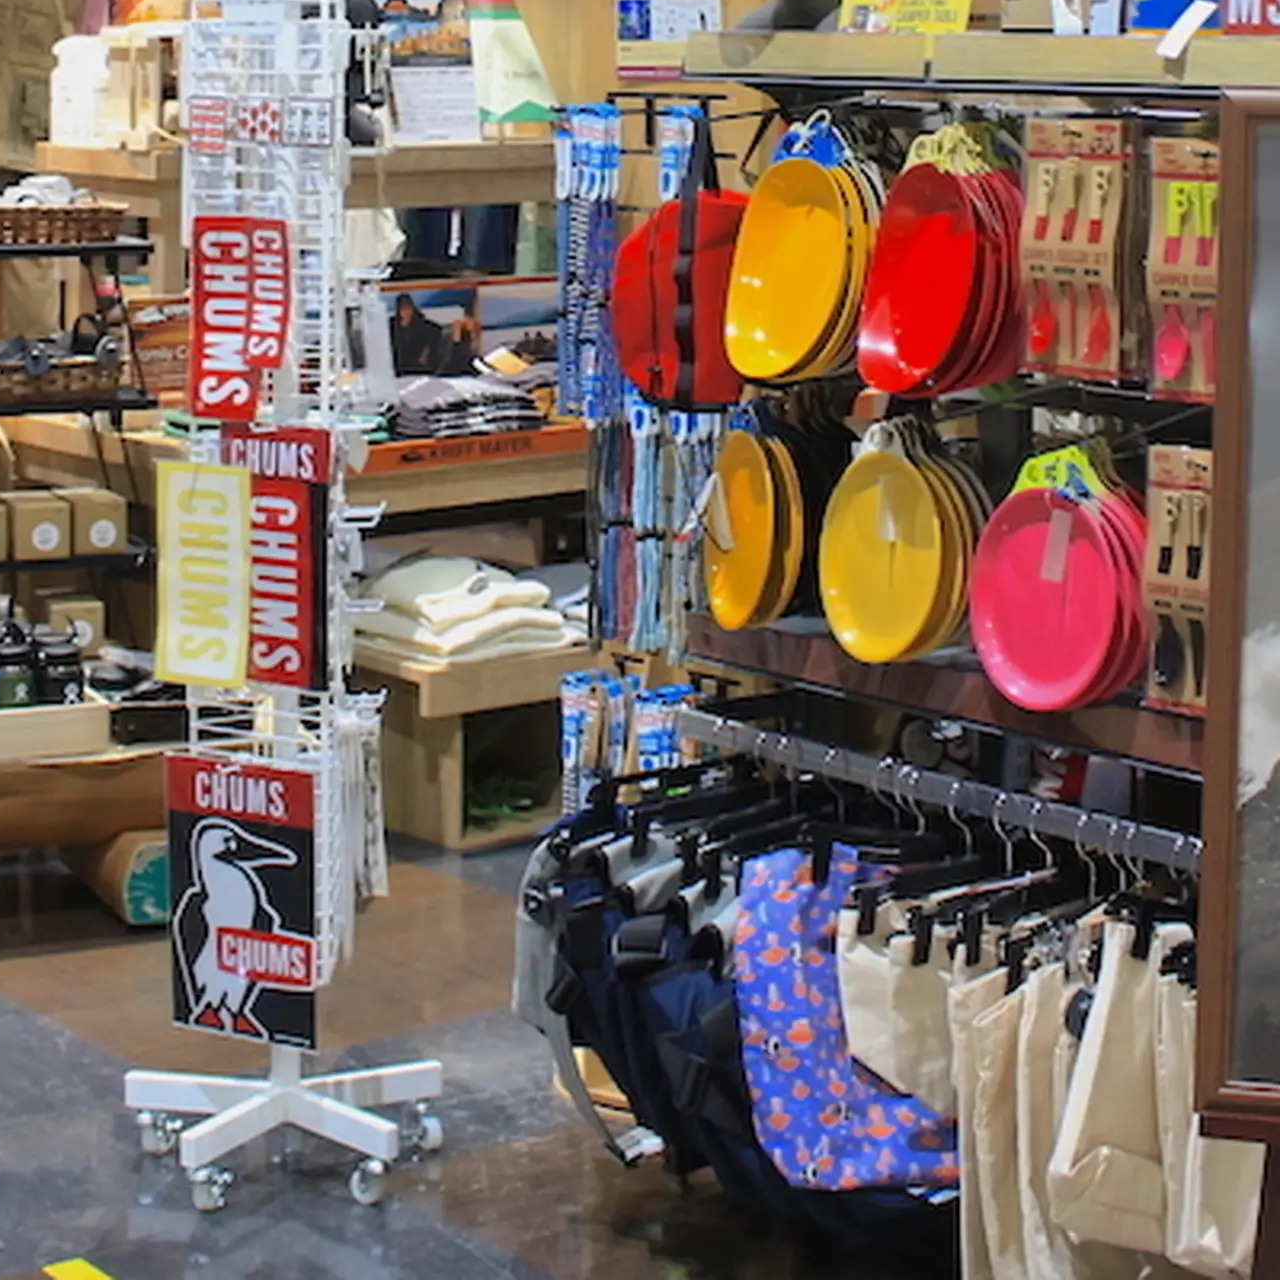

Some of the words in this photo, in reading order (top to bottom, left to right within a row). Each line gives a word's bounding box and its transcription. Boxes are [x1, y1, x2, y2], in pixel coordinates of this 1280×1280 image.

[198, 230, 251, 407] CHUMS
[248, 228, 285, 358] CHUMS
[229, 437, 317, 480] CHUMS
[175, 488, 231, 669] CHUMS
[250, 495, 301, 676] CHUMS
[194, 771, 287, 817] CHUMS
[220, 934, 308, 982] CHUMS
